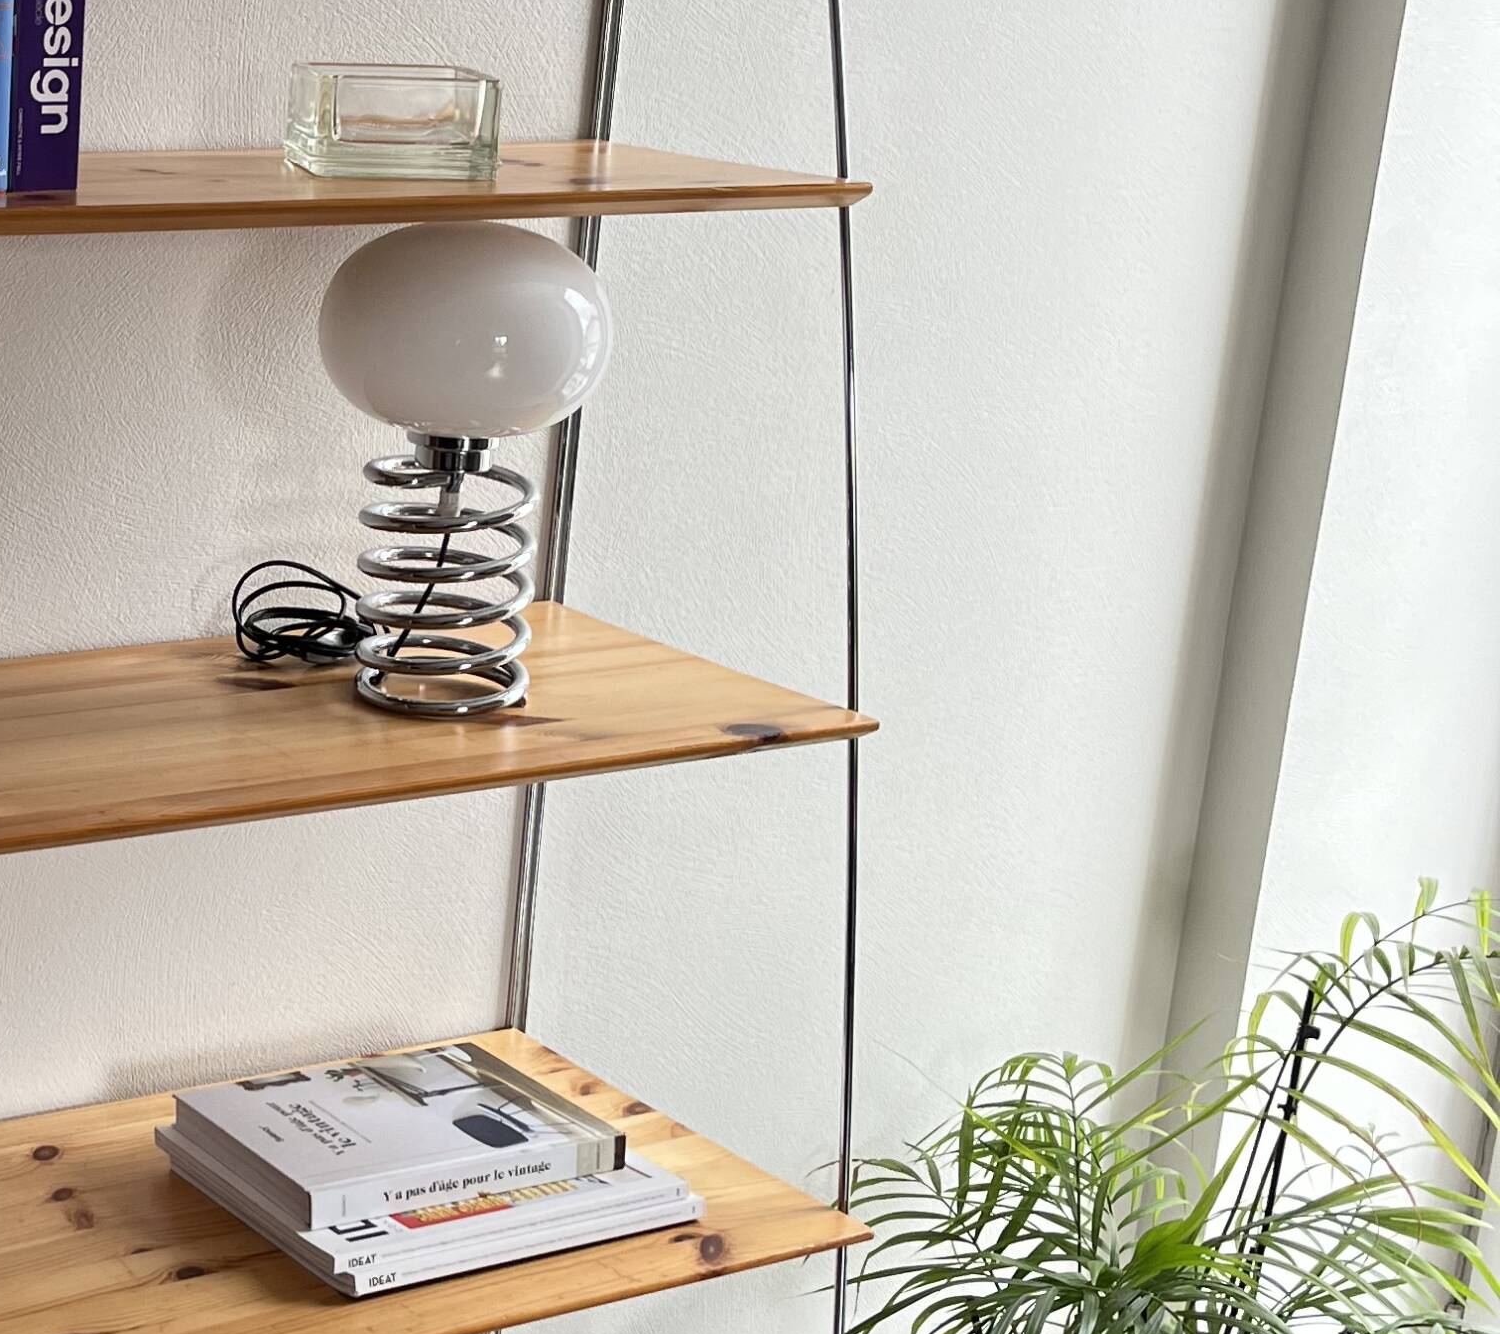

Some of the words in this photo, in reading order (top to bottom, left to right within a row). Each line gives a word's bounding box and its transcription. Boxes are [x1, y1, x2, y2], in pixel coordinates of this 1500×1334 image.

[383, 1191, 393, 1202] Y
[395, 1192, 403, 1200] a
[406, 1185, 426, 1200] pas
[462, 1173, 491, 1189] pour
[493, 1169, 505, 1181] le
[508, 1161, 552, 1177] vintage
[348, 1253, 377, 1268] IDEAT
[369, 1272, 397, 1287] IDEAT
